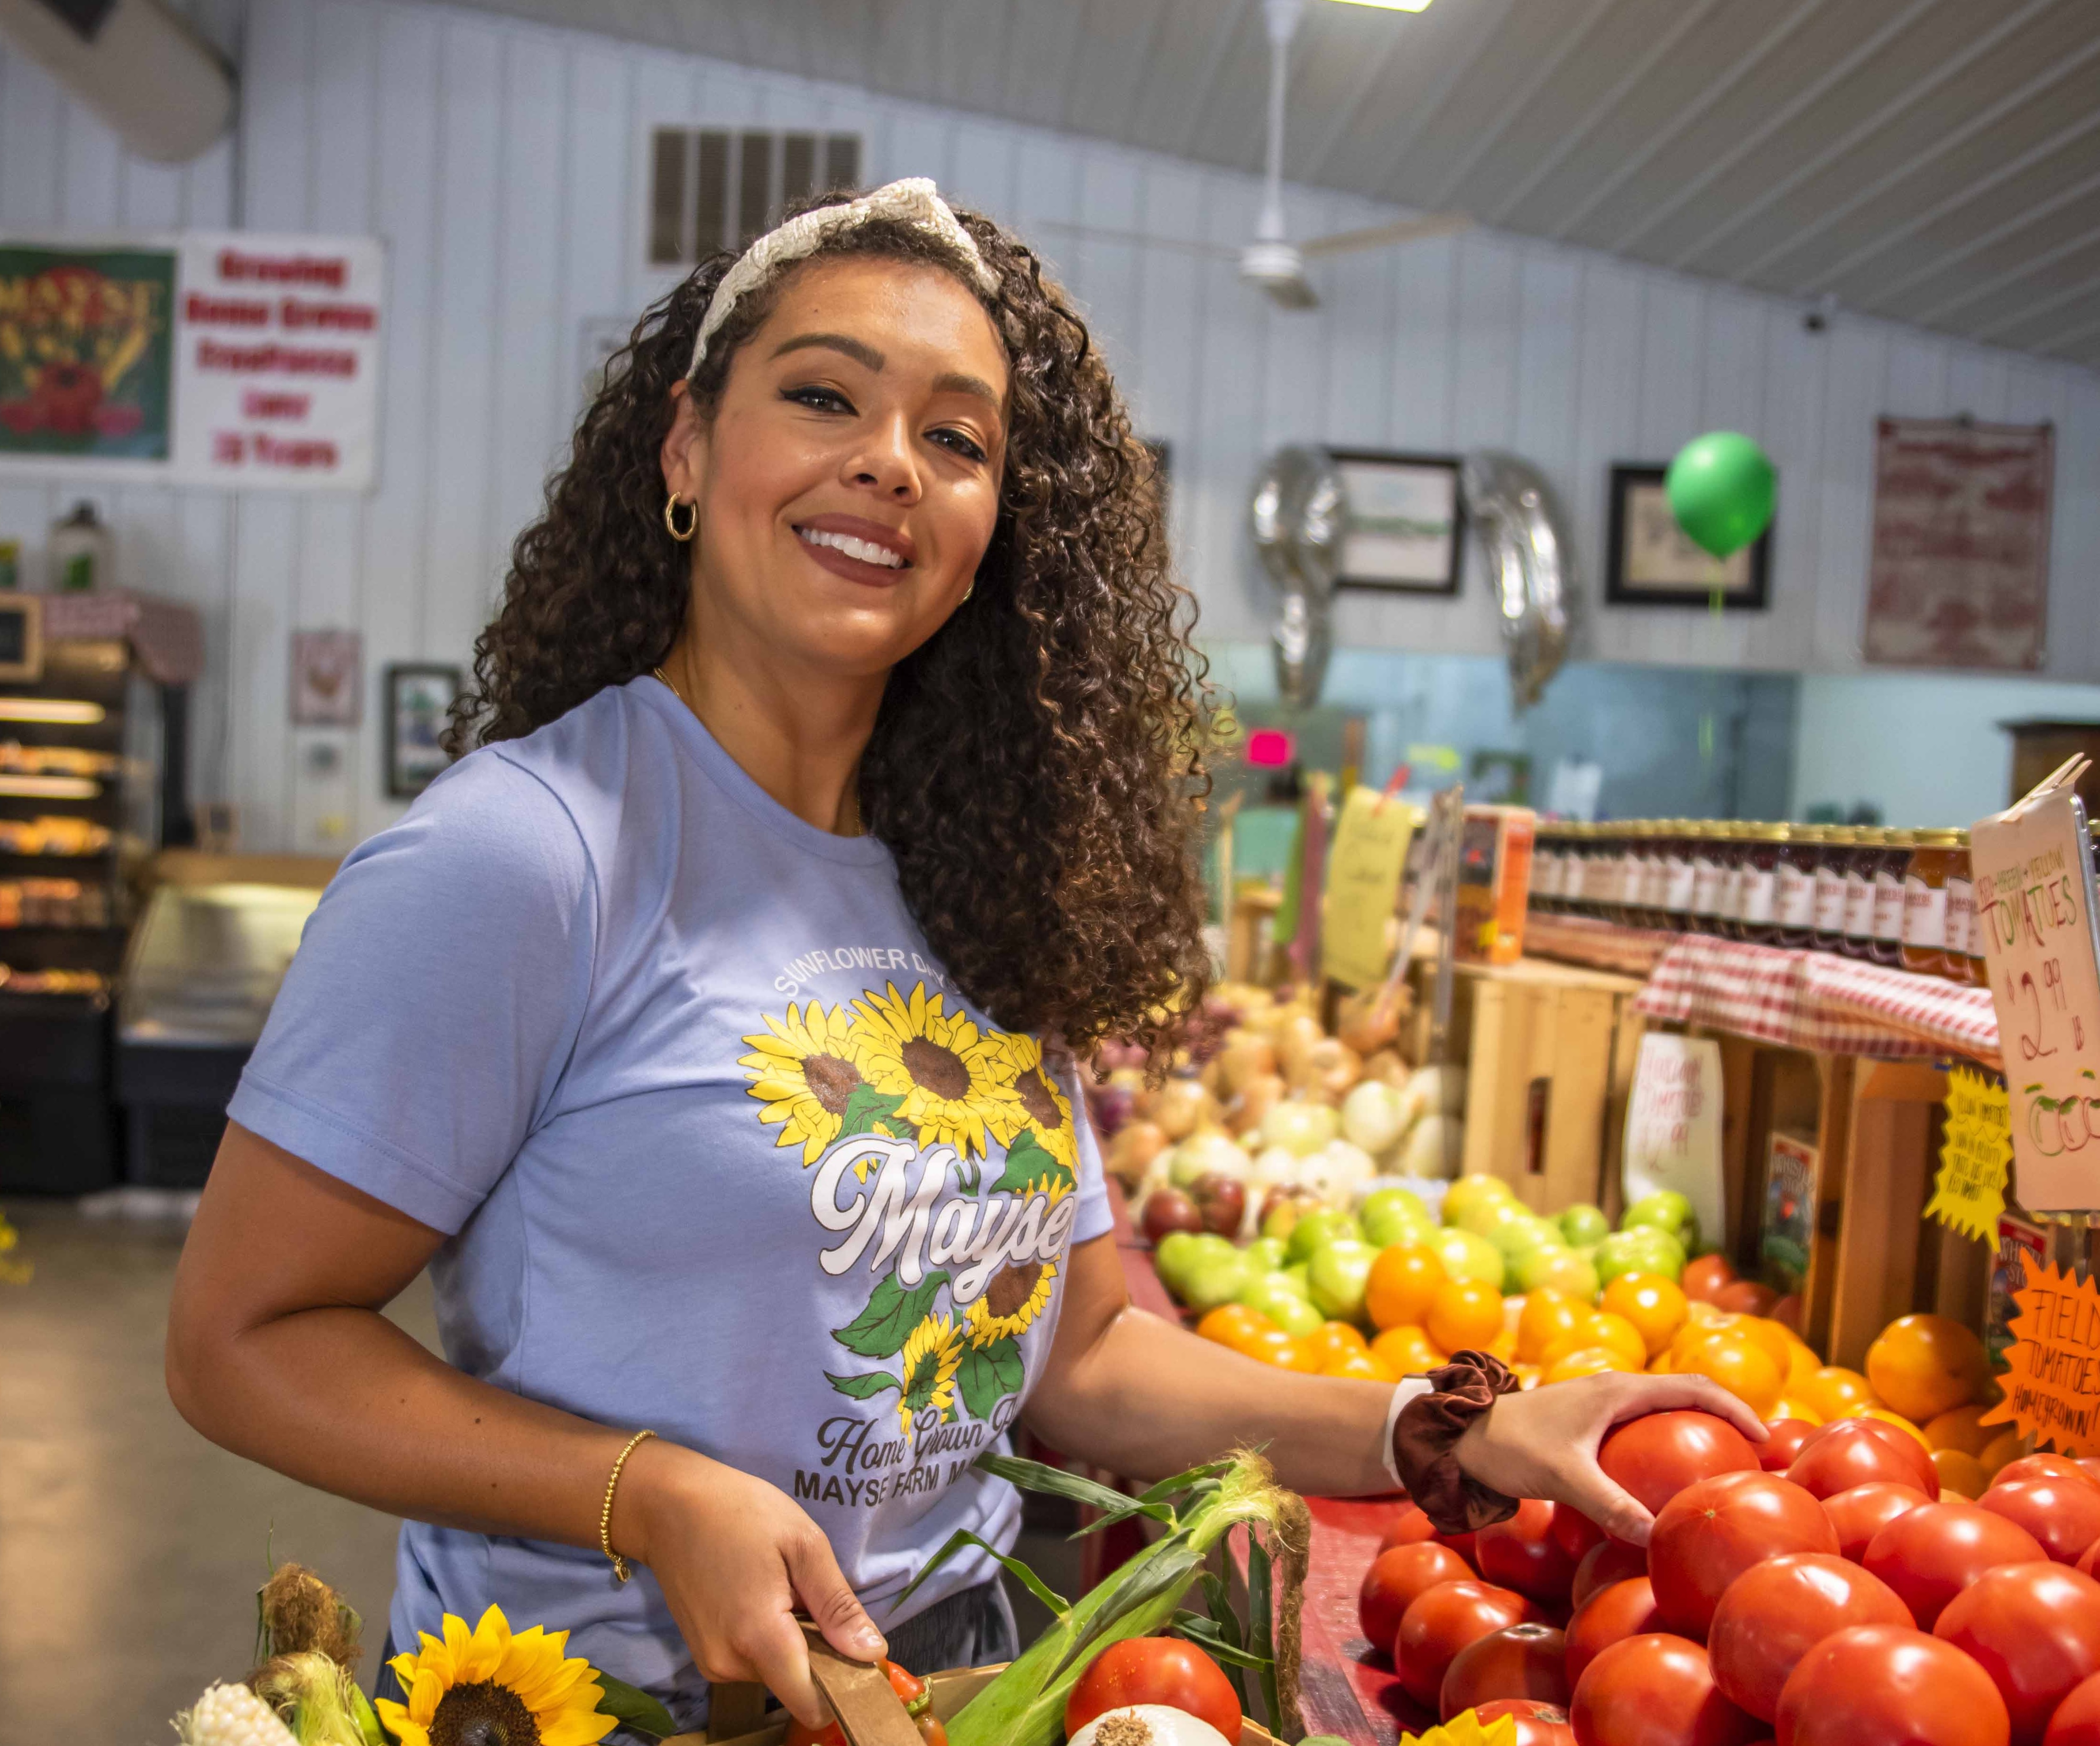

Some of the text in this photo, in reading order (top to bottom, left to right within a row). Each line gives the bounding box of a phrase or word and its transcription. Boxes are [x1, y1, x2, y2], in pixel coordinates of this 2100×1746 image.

[1981, 874, 2077, 953] TOMATOES
[774, 947, 908, 997] SUNFLOWER
[811, 1138, 1075, 1303] Mayse
[2031, 1289, 2100, 1351] FIELD
[817, 1417, 905, 1475] Home
[914, 1409, 985, 1469] Grown
[794, 1469, 890, 1507] MAYSE
[891, 1462, 939, 1499] FARM
